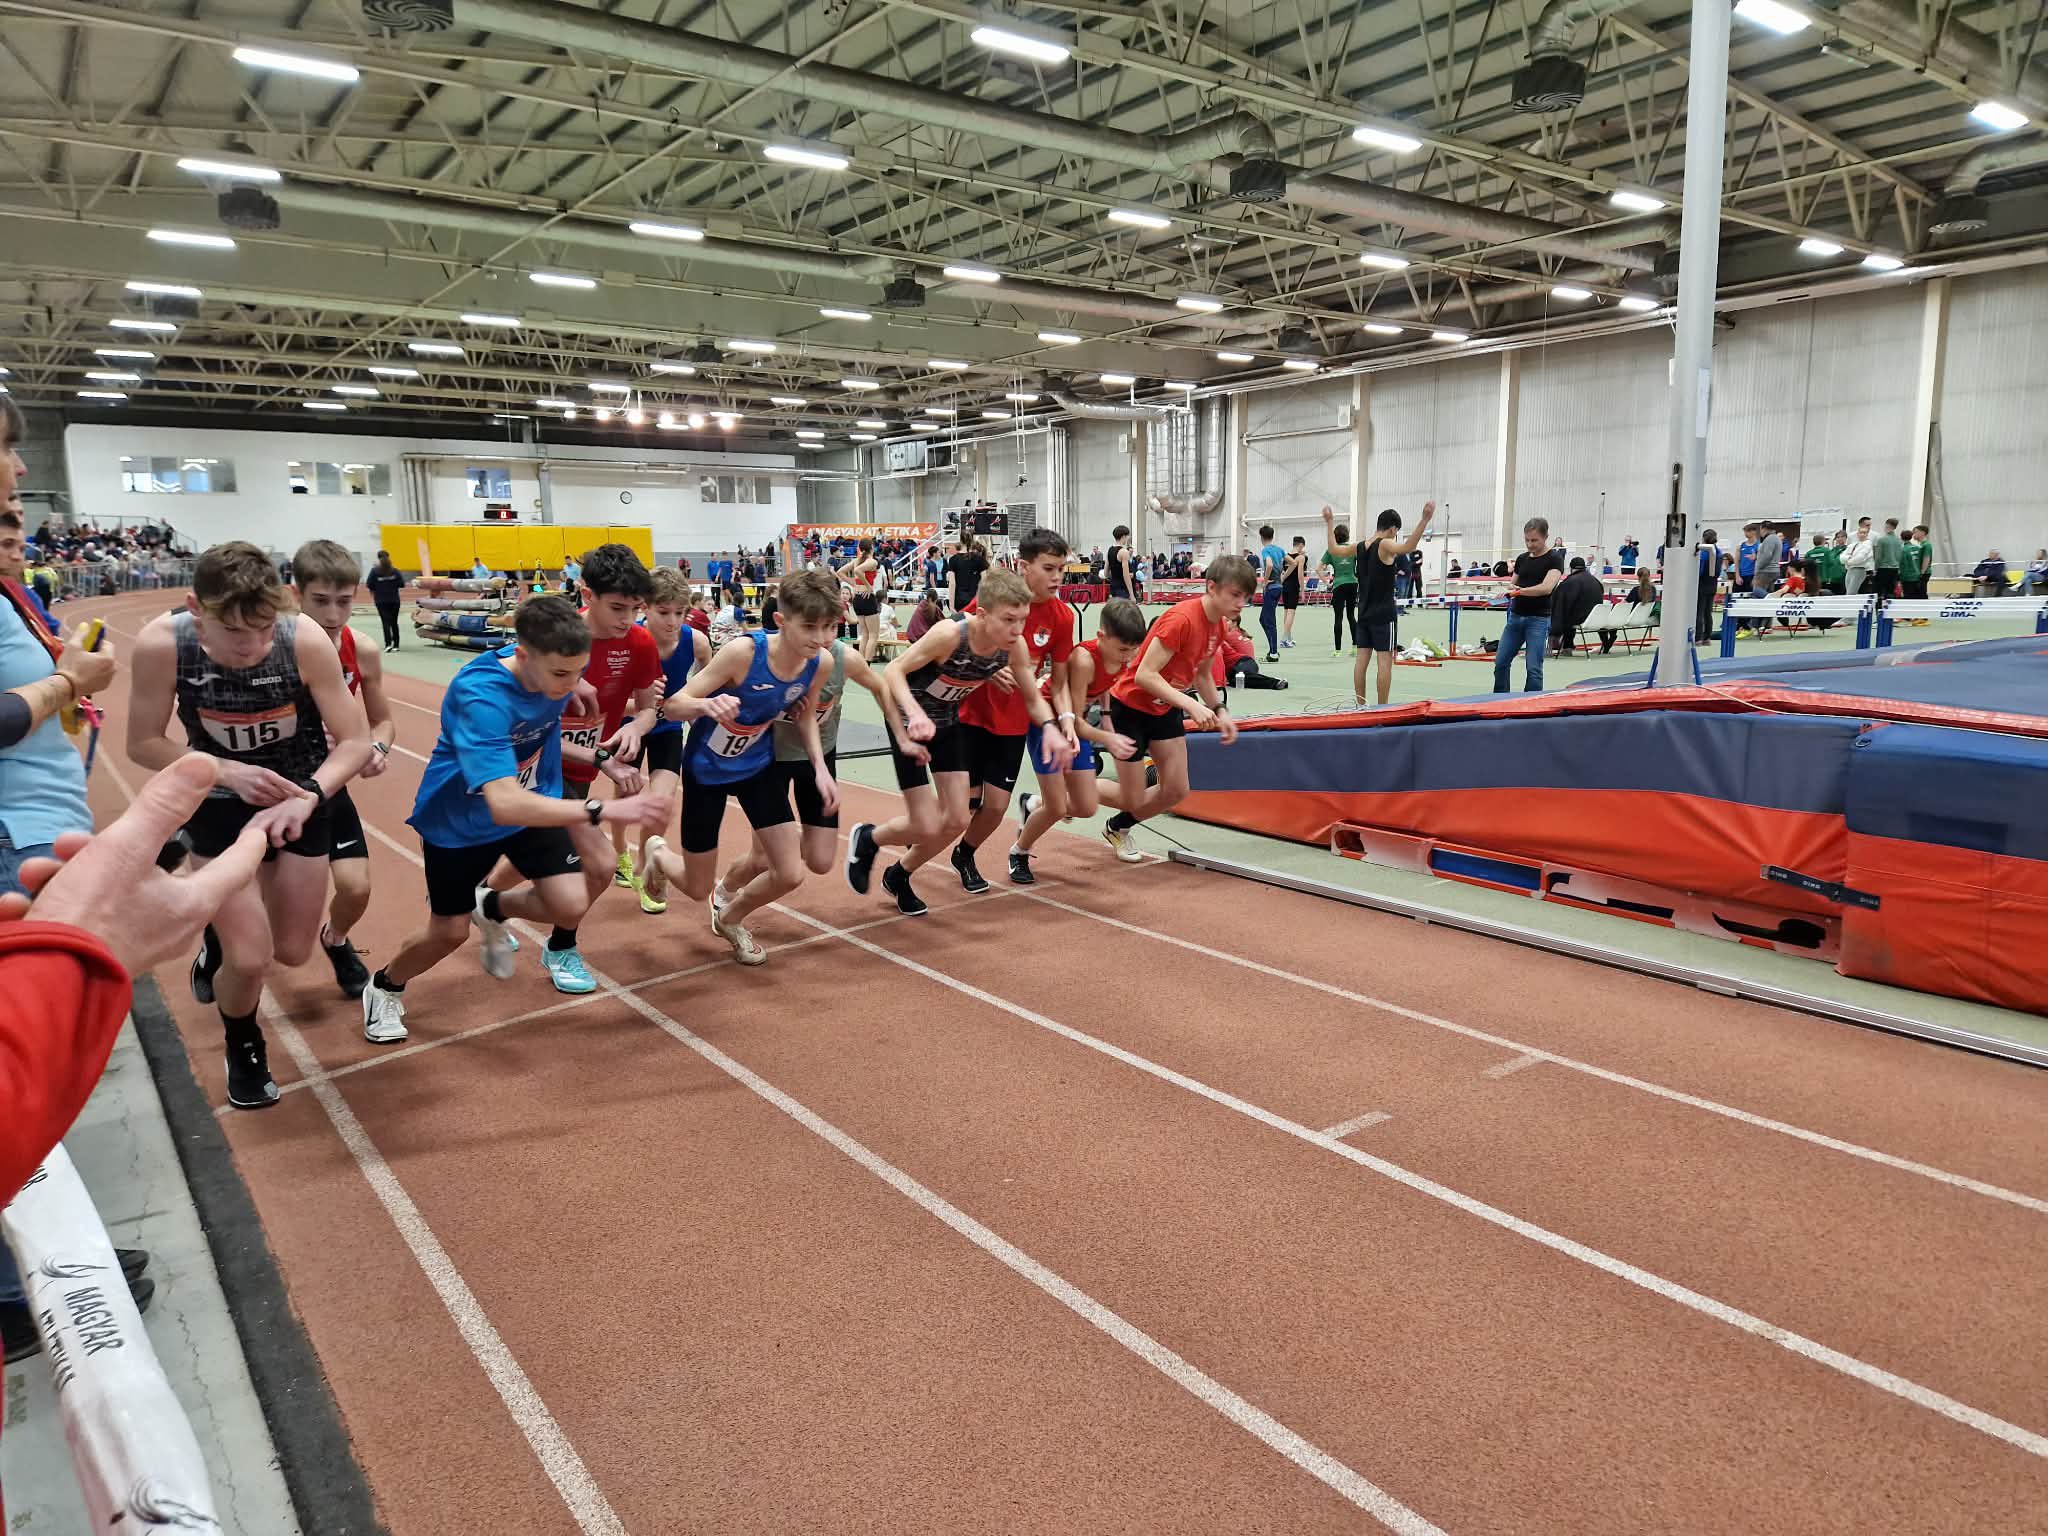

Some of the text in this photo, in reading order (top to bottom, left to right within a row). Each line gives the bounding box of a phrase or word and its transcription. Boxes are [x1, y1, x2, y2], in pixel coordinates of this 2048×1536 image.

[864, 526, 920, 537] ATETIKA
[223, 721, 280, 750] 115
[721, 733, 758, 755] 19
[516, 766, 532, 789] 9
[64, 1286, 125, 1357] MAGYAR
